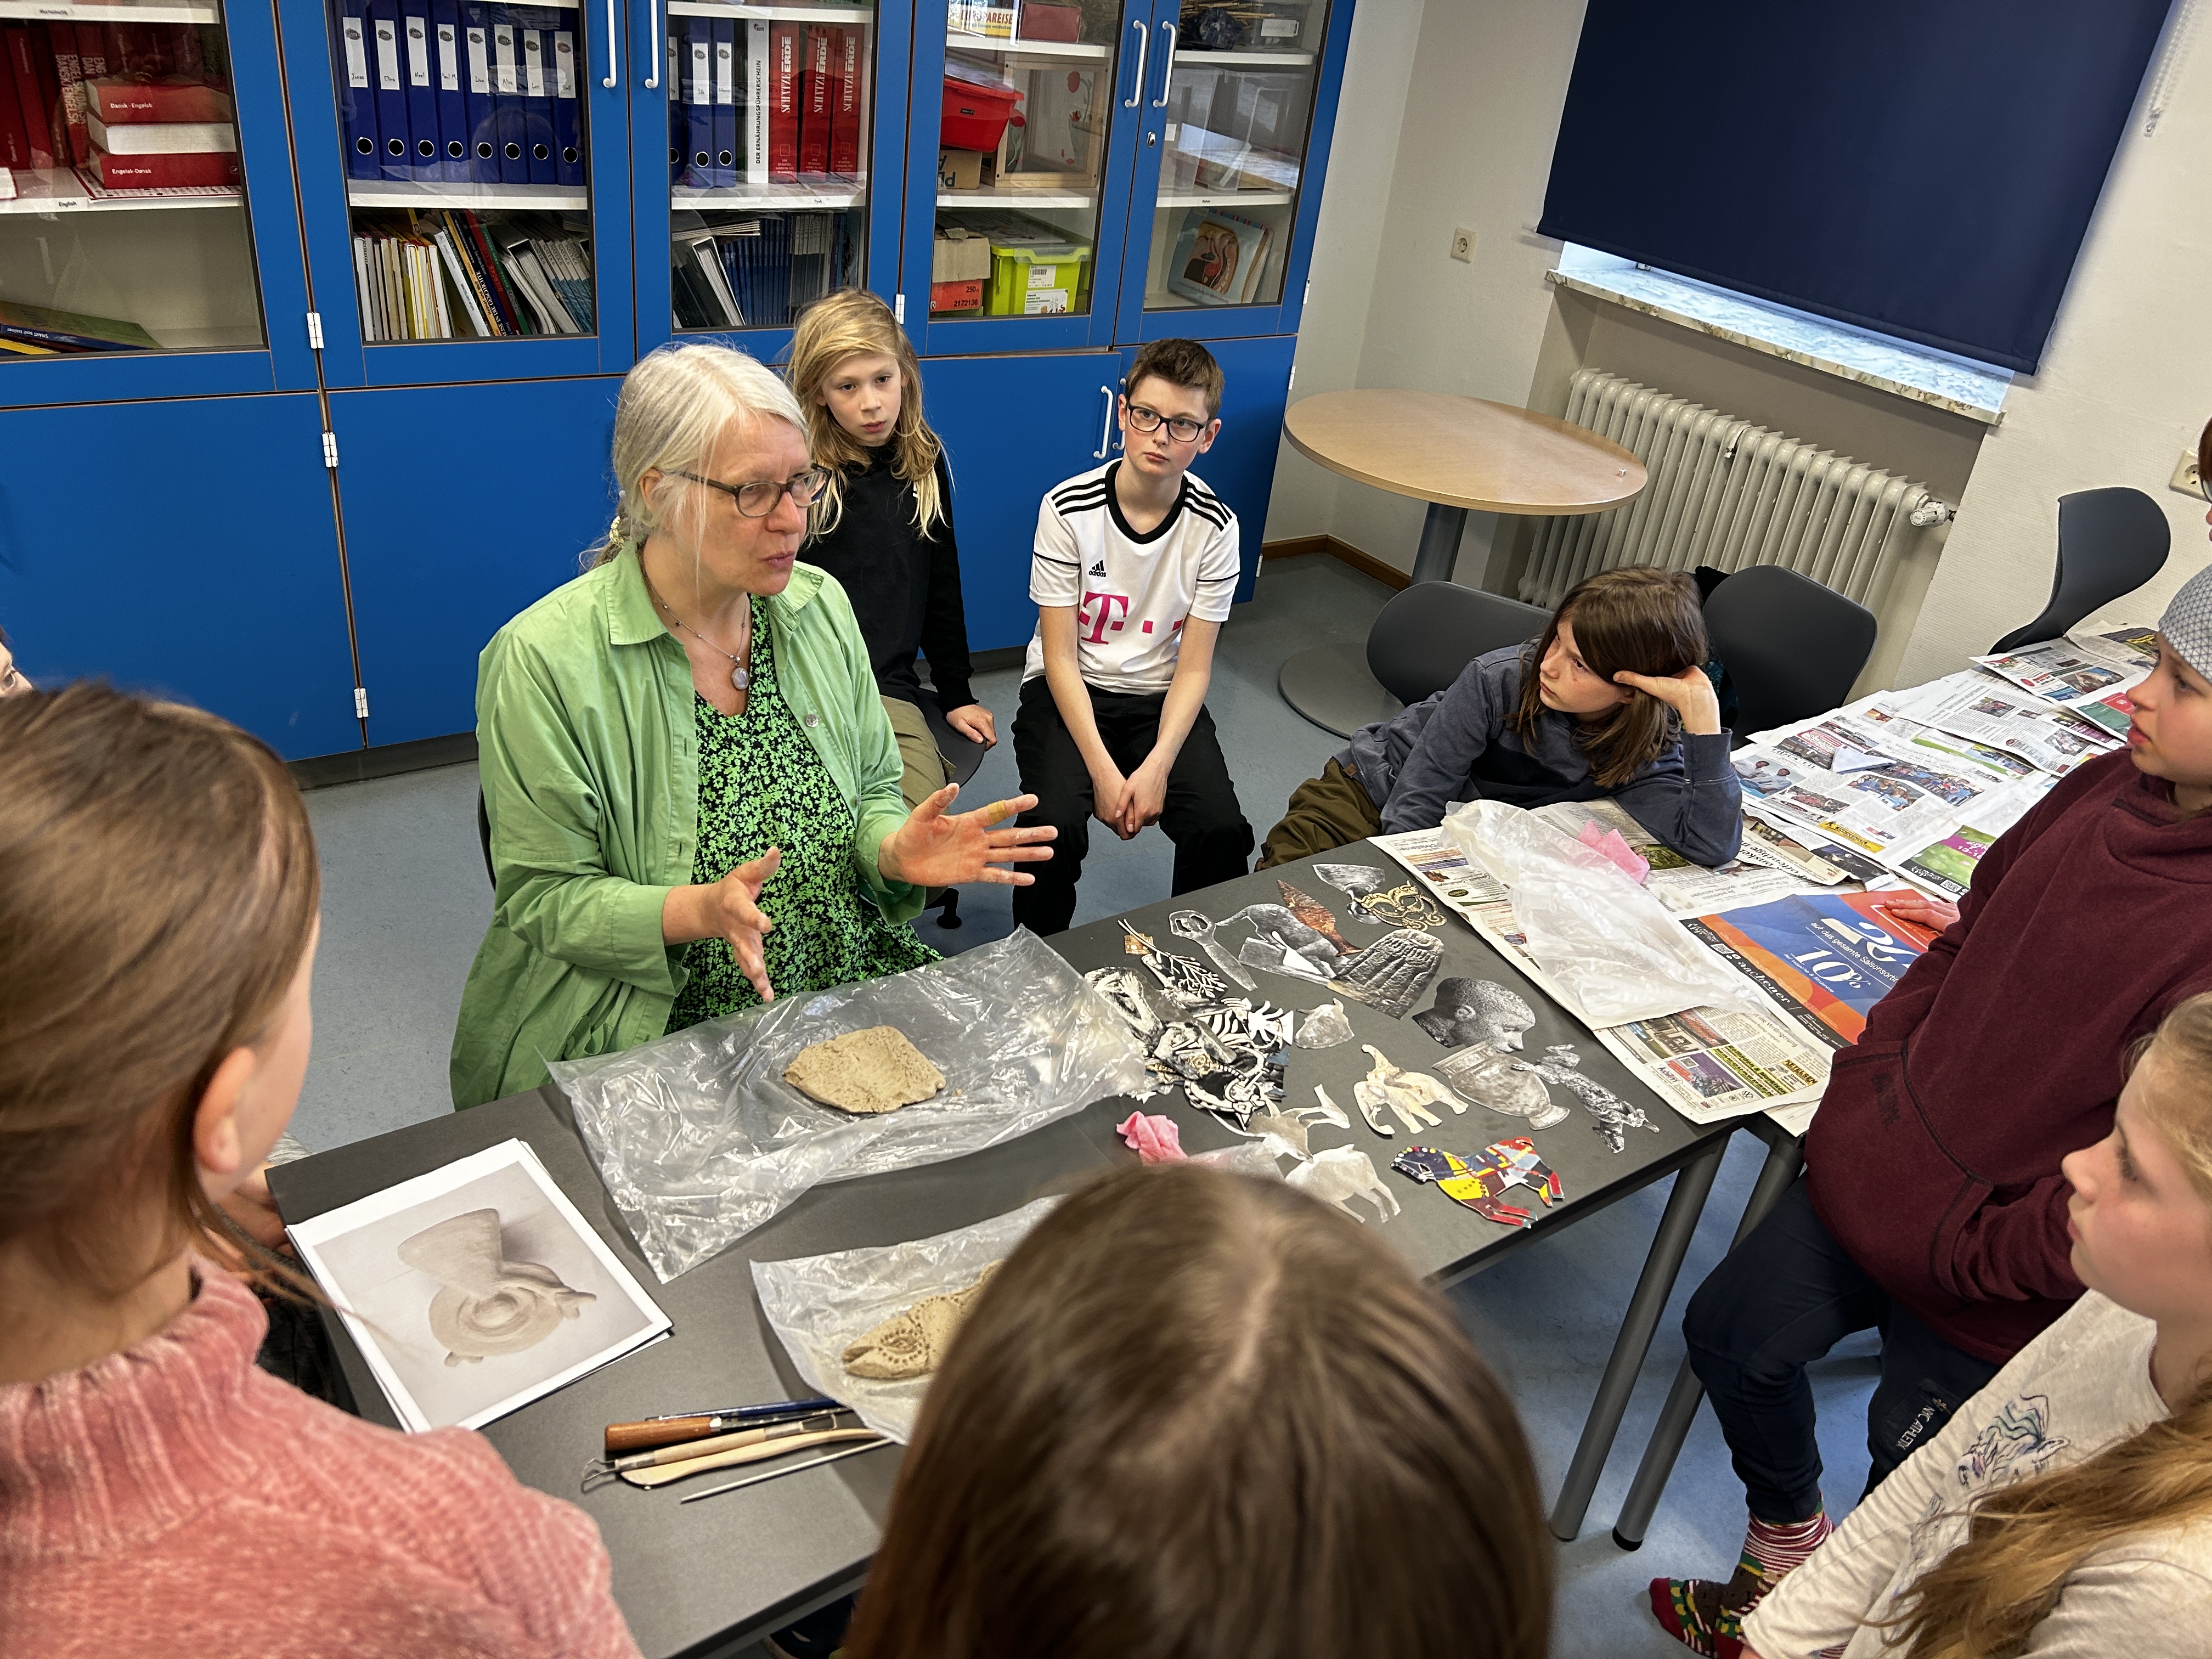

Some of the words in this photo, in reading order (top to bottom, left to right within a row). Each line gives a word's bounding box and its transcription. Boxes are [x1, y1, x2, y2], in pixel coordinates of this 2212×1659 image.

[966, 285, 977, 294] 250
[953, 298, 978, 307] 2172136
[1089, 569, 1107, 578] adidas
[1081, 591, 1129, 645] T
[1810, 922, 1825, 934] auf
[1821, 929, 1835, 940] das
[1832, 939, 1861, 958] gesamte
[1737, 961, 1791, 1004] aachener
[1766, 1018, 1798, 1048] Verlängerung
[1917, 1404, 1936, 1423] NYC
